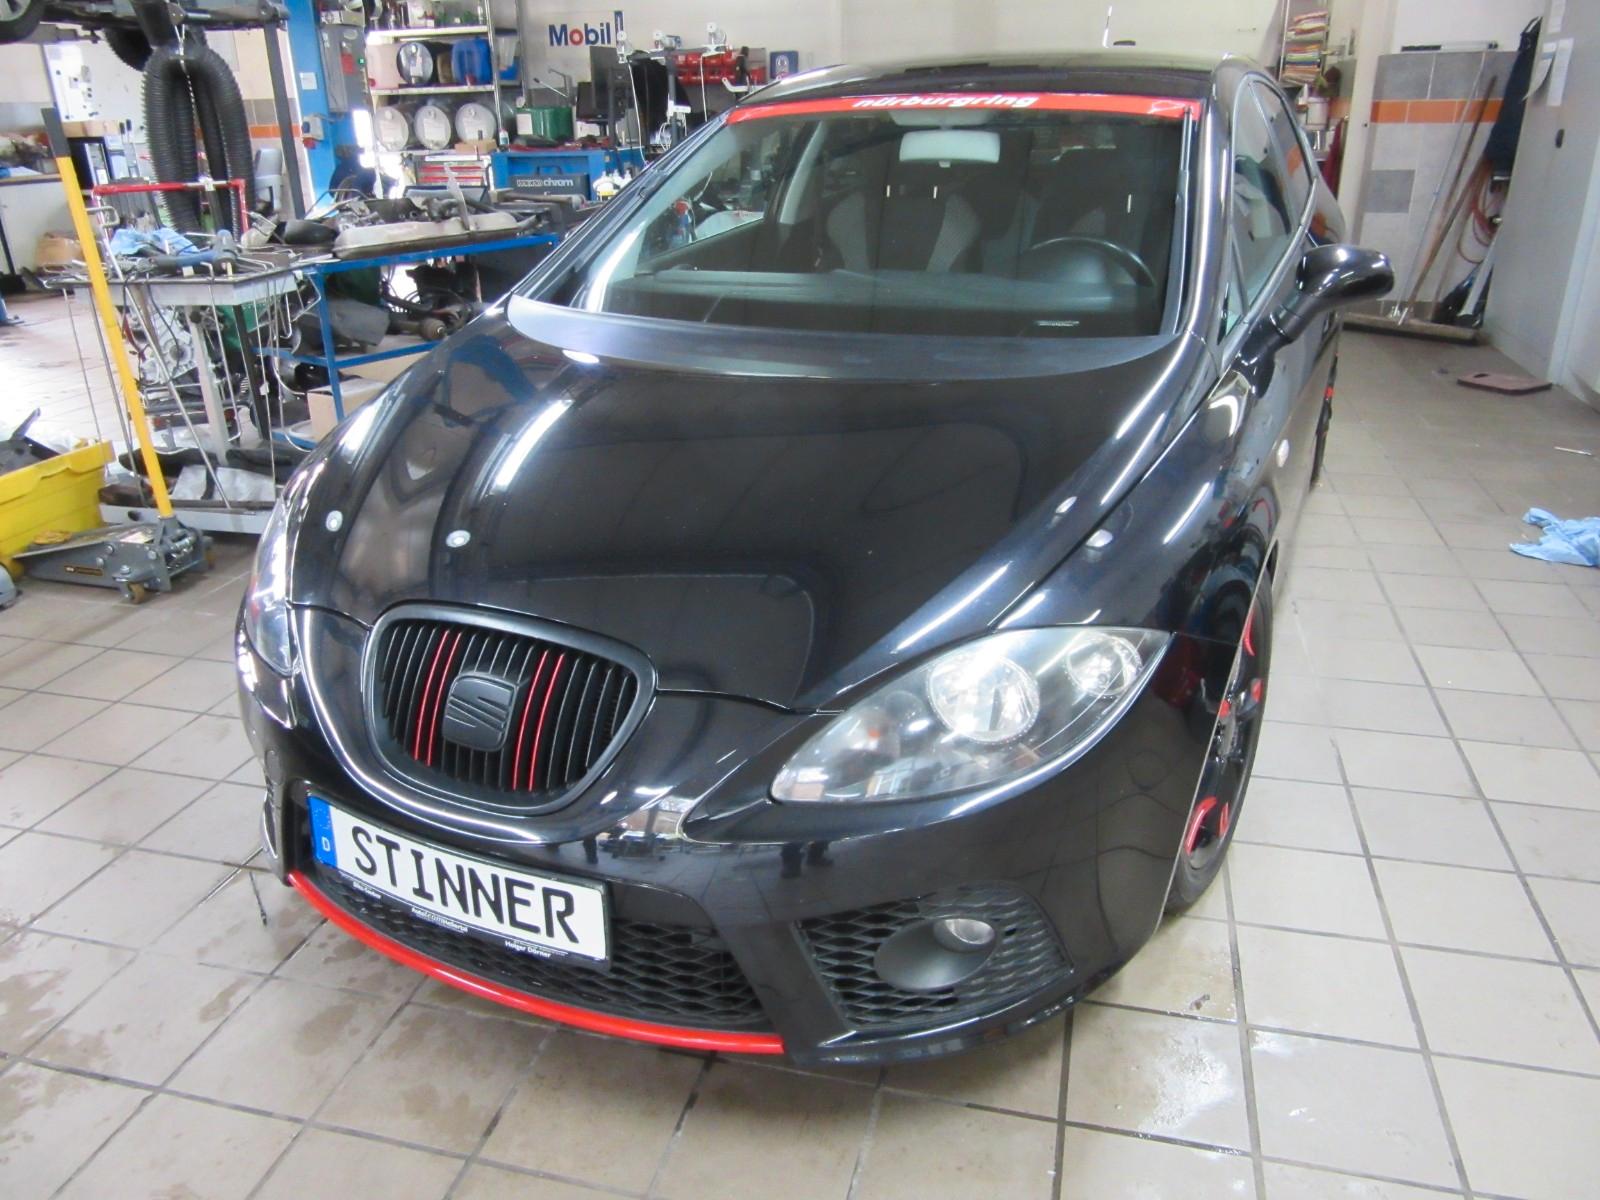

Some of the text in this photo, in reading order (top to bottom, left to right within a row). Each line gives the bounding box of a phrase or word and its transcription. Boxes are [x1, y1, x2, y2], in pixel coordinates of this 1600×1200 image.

[548, 22, 611, 46] Mobil
[321, 837, 331, 852] D
[351, 825, 580, 944] STINNER
